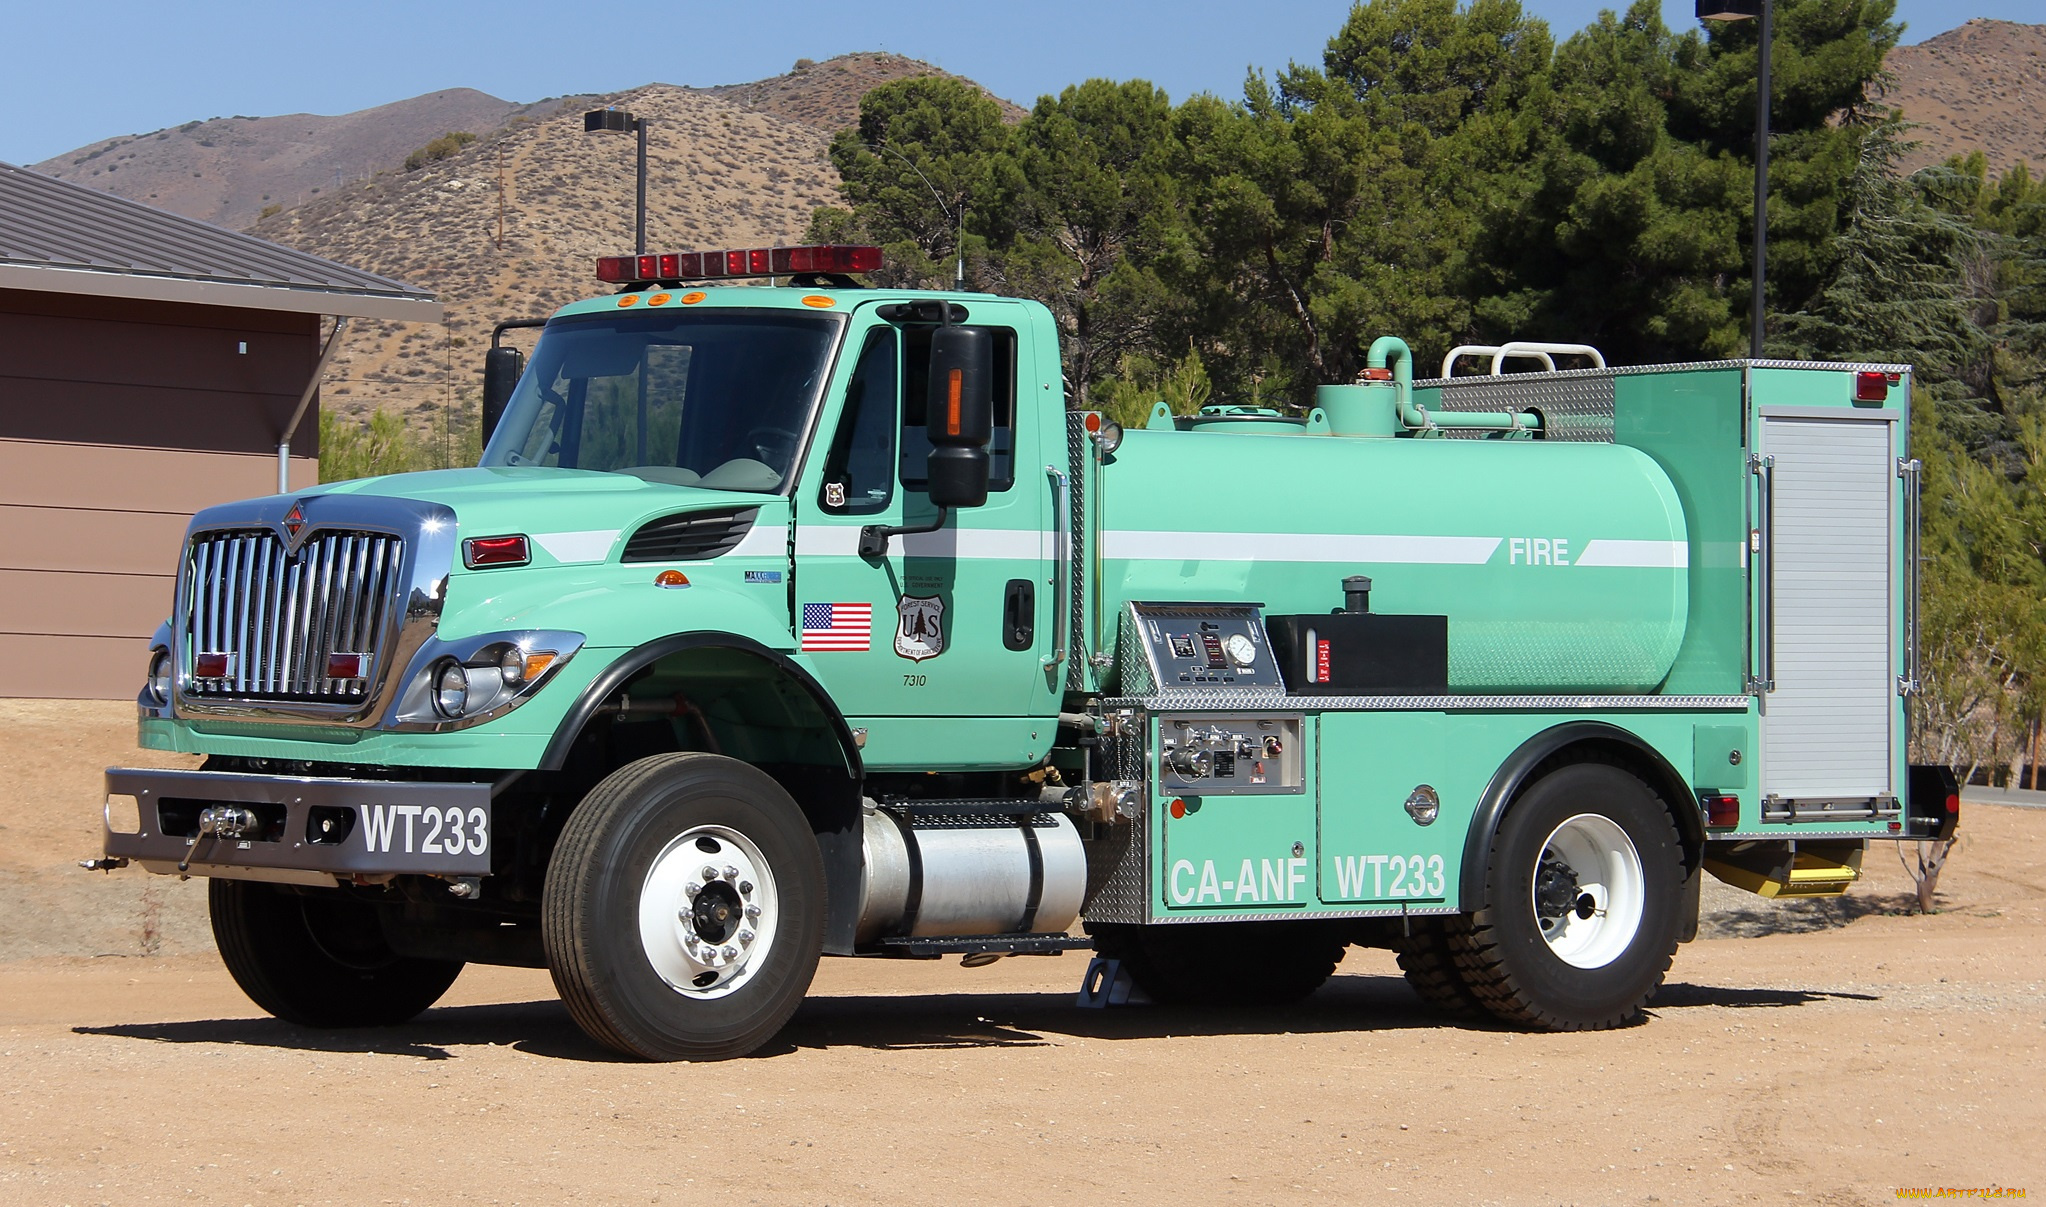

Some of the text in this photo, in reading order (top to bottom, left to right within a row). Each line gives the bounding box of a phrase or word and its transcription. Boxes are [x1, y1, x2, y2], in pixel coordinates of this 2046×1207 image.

[1509, 538, 1570, 566] FIRE
[901, 601, 940, 612] FOREST SERVICE
[903, 675, 927, 687] 7310
[360, 804, 488, 856] WT233
[1170, 858, 1308, 905] CA-ANF
[1333, 854, 1446, 899] WT233
